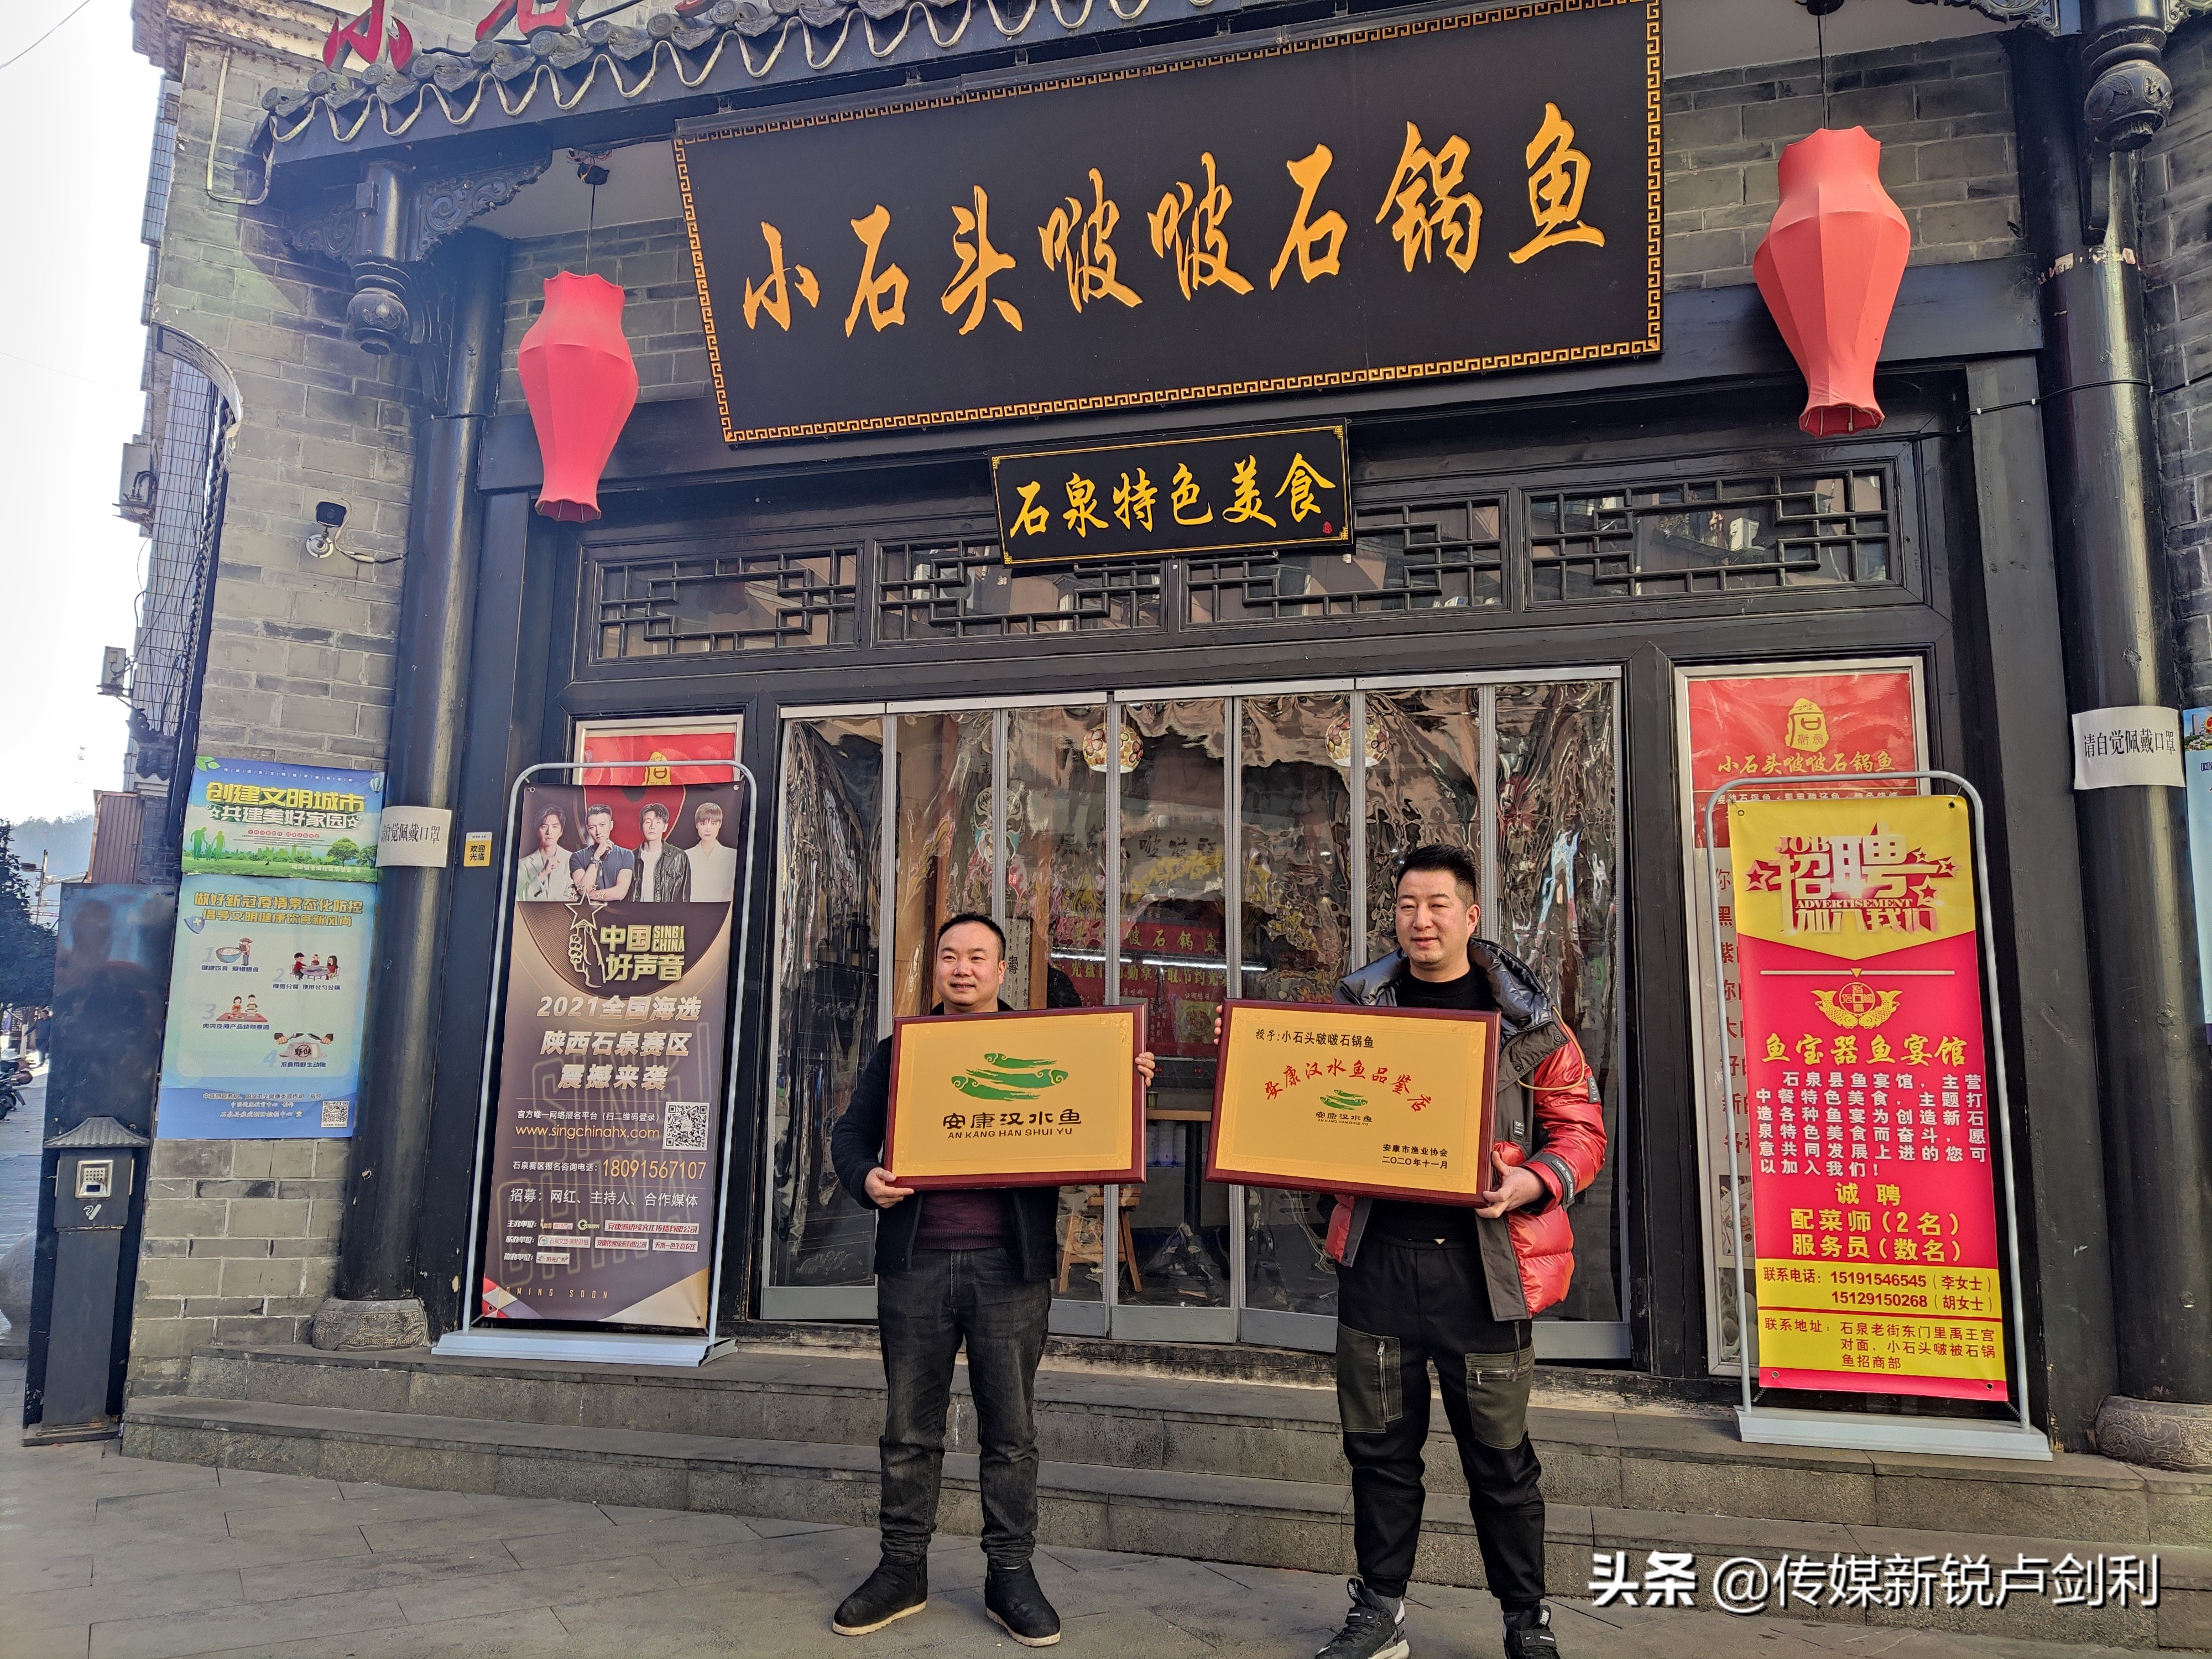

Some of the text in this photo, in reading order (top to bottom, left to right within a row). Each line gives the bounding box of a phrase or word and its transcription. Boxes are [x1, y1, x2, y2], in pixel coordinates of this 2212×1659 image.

[743, 102, 1604, 336] 小石头啵啵石锅鱼
[1010, 452, 1336, 538] 石泉特色美食
[2083, 728, 2176, 758] 请自觉佩戴口罩
[1718, 750, 1896, 775] 小石头啵啵石锅鱼
[206, 782, 366, 813] 创建文明城市
[221, 806, 348, 829] 共建美好家园
[470, 844, 486, 853] 欢迎
[1774, 836, 1830, 853] JOB
[1768, 822, 1941, 932] 招聘
[194, 892, 363, 914] 做好新冠疫情常态化防控
[1796, 898, 1914, 909] ADVERTISEMENT
[202, 909, 352, 926] 倡导文明健康饮食新风尚
[1796, 907, 1939, 933] 加入我们
[599, 924, 651, 953] 中国
[653, 925, 685, 938] SING!
[653, 938, 685, 952] CHINA
[605, 953, 685, 981] 好声音
[536, 995, 702, 1021] 2021全国海选
[540, 1030, 693, 1057] 陕西石泉赛区
[1761, 1033, 1968, 1067] 鱼宝器鱼宴馆
[557, 1064, 669, 1092] 震撼来袭
[1782, 1071, 1982, 1090] 石泉县鱼宴馆，主营
[1756, 1088, 1984, 1108] 中餐特色美食，主题打
[943, 1109, 1082, 1130] 安康汉水鱼
[1316, 1112, 1373, 1122] 安康汉水鱼
[1756, 1106, 1985, 1127] 造各种鱼宴为创造新石
[515, 1125, 660, 1140] www.singchinahx.com
[965, 1130, 995, 1139] KANG
[1757, 1123, 1986, 1145] 泉特色美食而奋斗，愿
[1383, 1144, 1448, 1157] 安康市渔业协会
[1759, 1140, 1986, 1162] 意共同发展上进的您可
[603, 1159, 706, 1180] 18091567107
[569, 1289, 608, 1299] SOON
[1840, 1322, 1995, 1342] 石泉老街东门里禹王宫
[1841, 1354, 1902, 1370] 鱼招商部
[1539, 1609, 1550, 1626] NIKE
